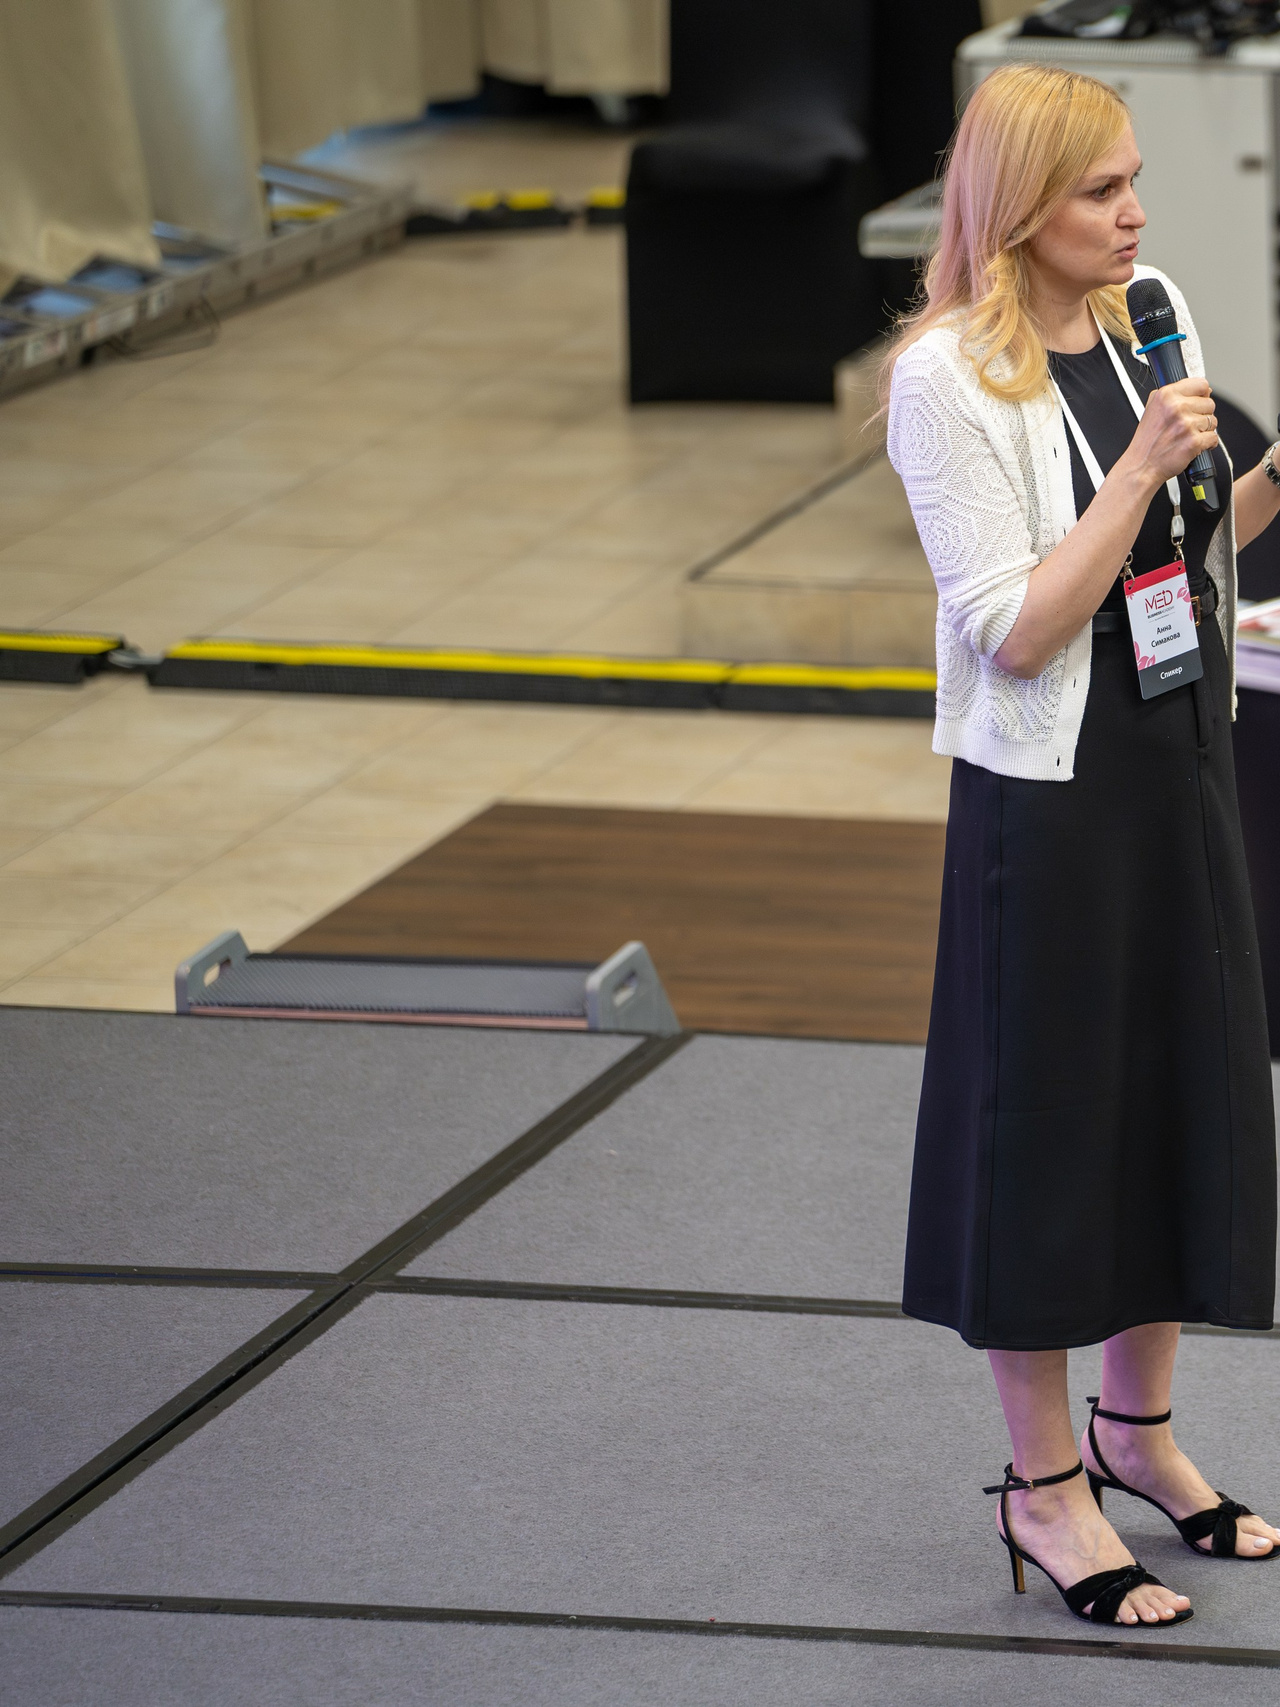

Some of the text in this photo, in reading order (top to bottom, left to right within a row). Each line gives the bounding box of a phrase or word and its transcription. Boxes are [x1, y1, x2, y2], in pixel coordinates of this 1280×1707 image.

[1145, 590, 1173, 613] MED
[1157, 624, 1172, 634] Анна
[1151, 632, 1180, 647] Симакова
[1160, 666, 1182, 679] Спикер
